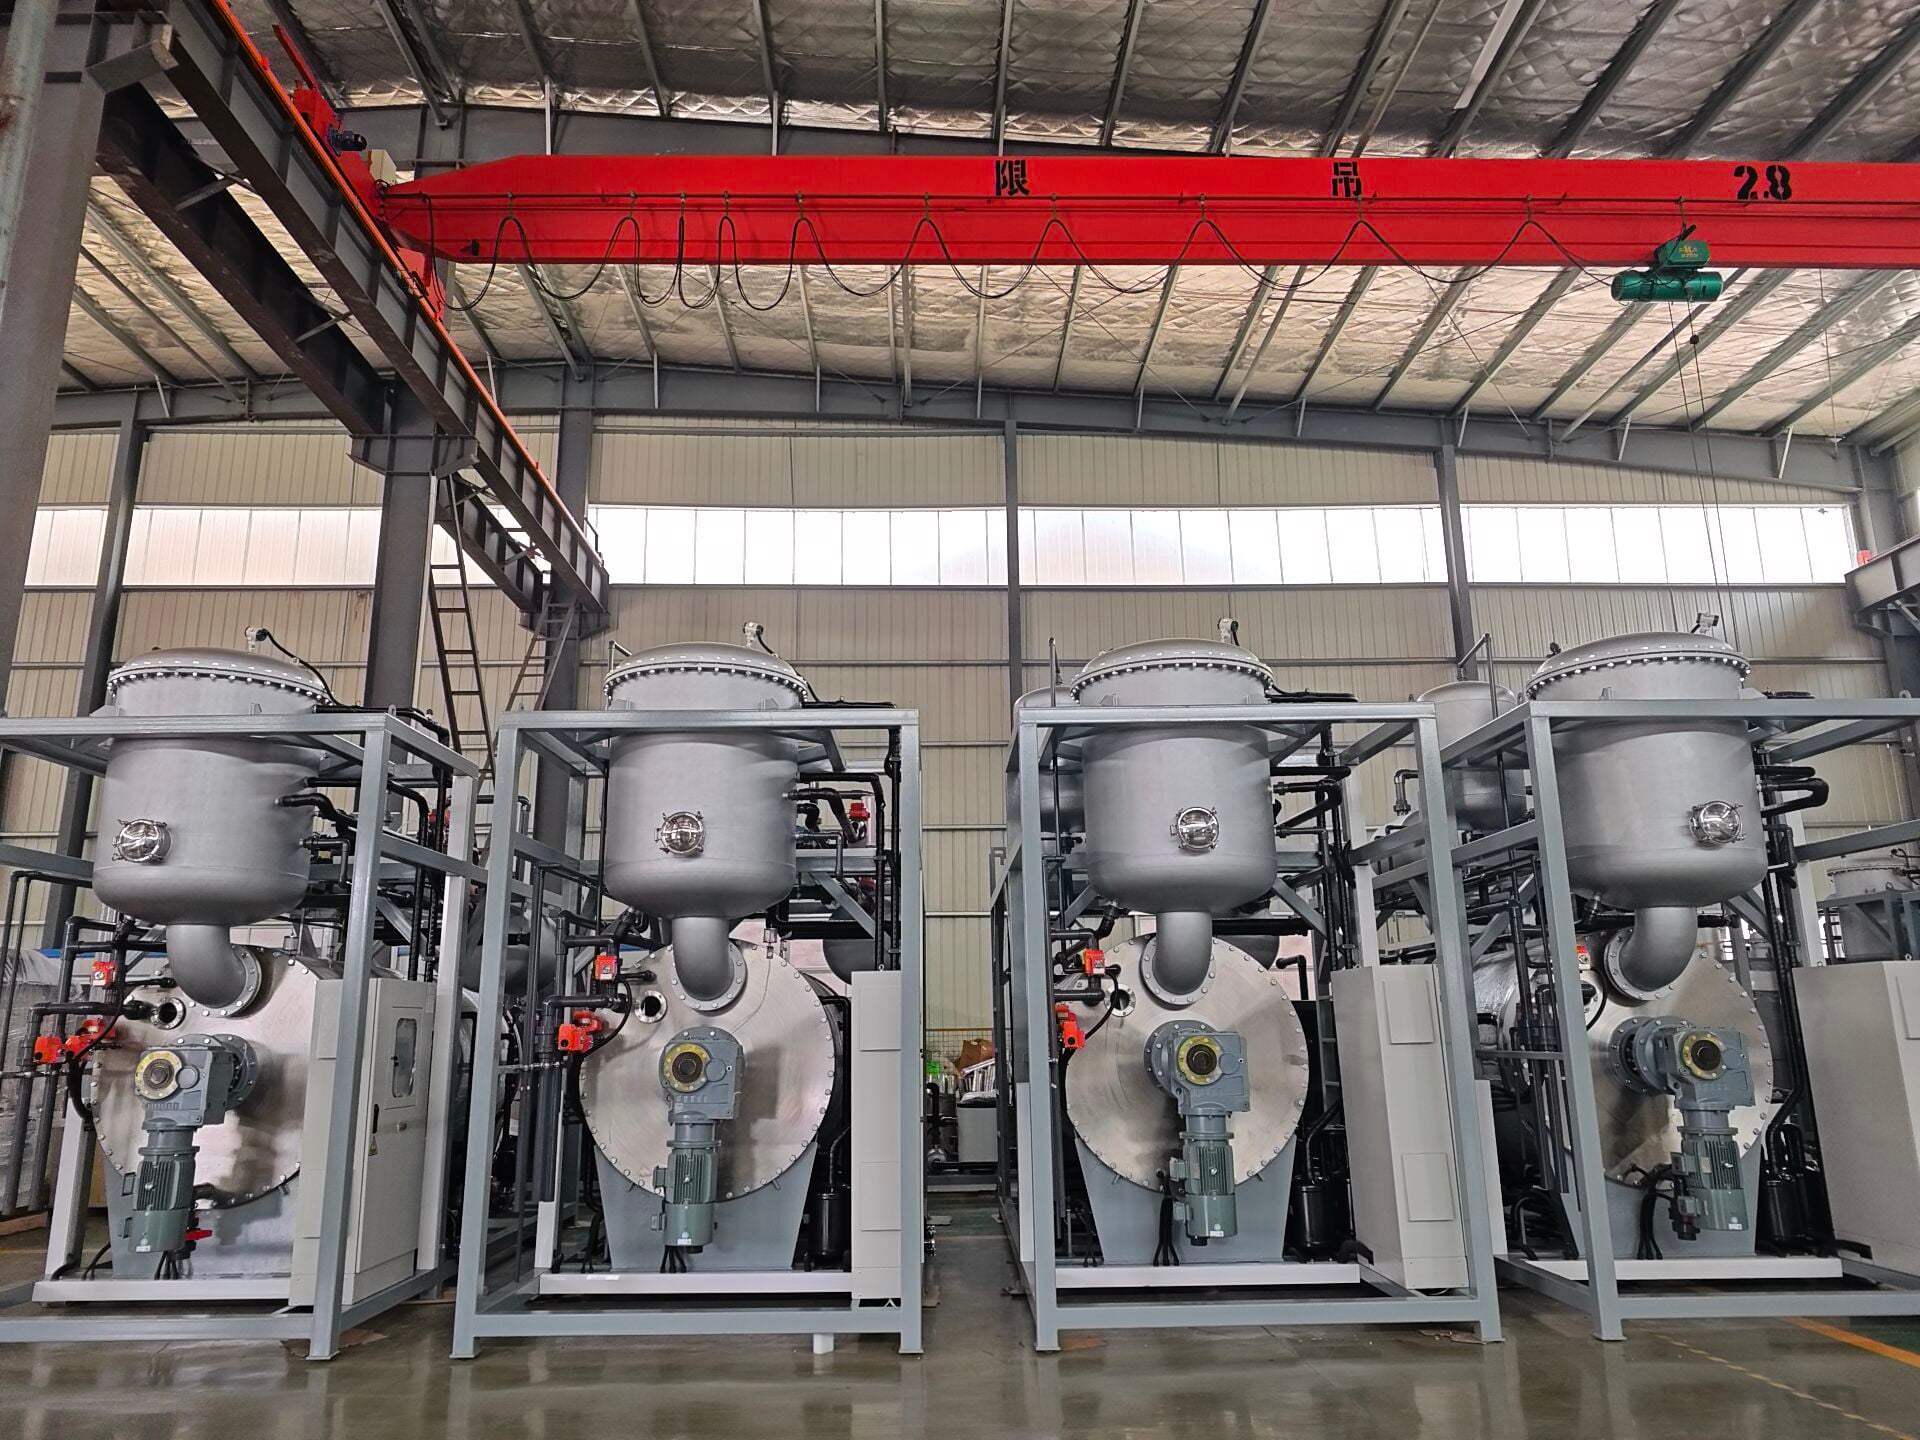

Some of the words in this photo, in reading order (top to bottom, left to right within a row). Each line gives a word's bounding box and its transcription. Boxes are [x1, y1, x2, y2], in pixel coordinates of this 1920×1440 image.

[995, 160, 1030, 196] 限
[1331, 161, 1362, 198] 吊
[1733, 164, 1792, 201] 2.8
